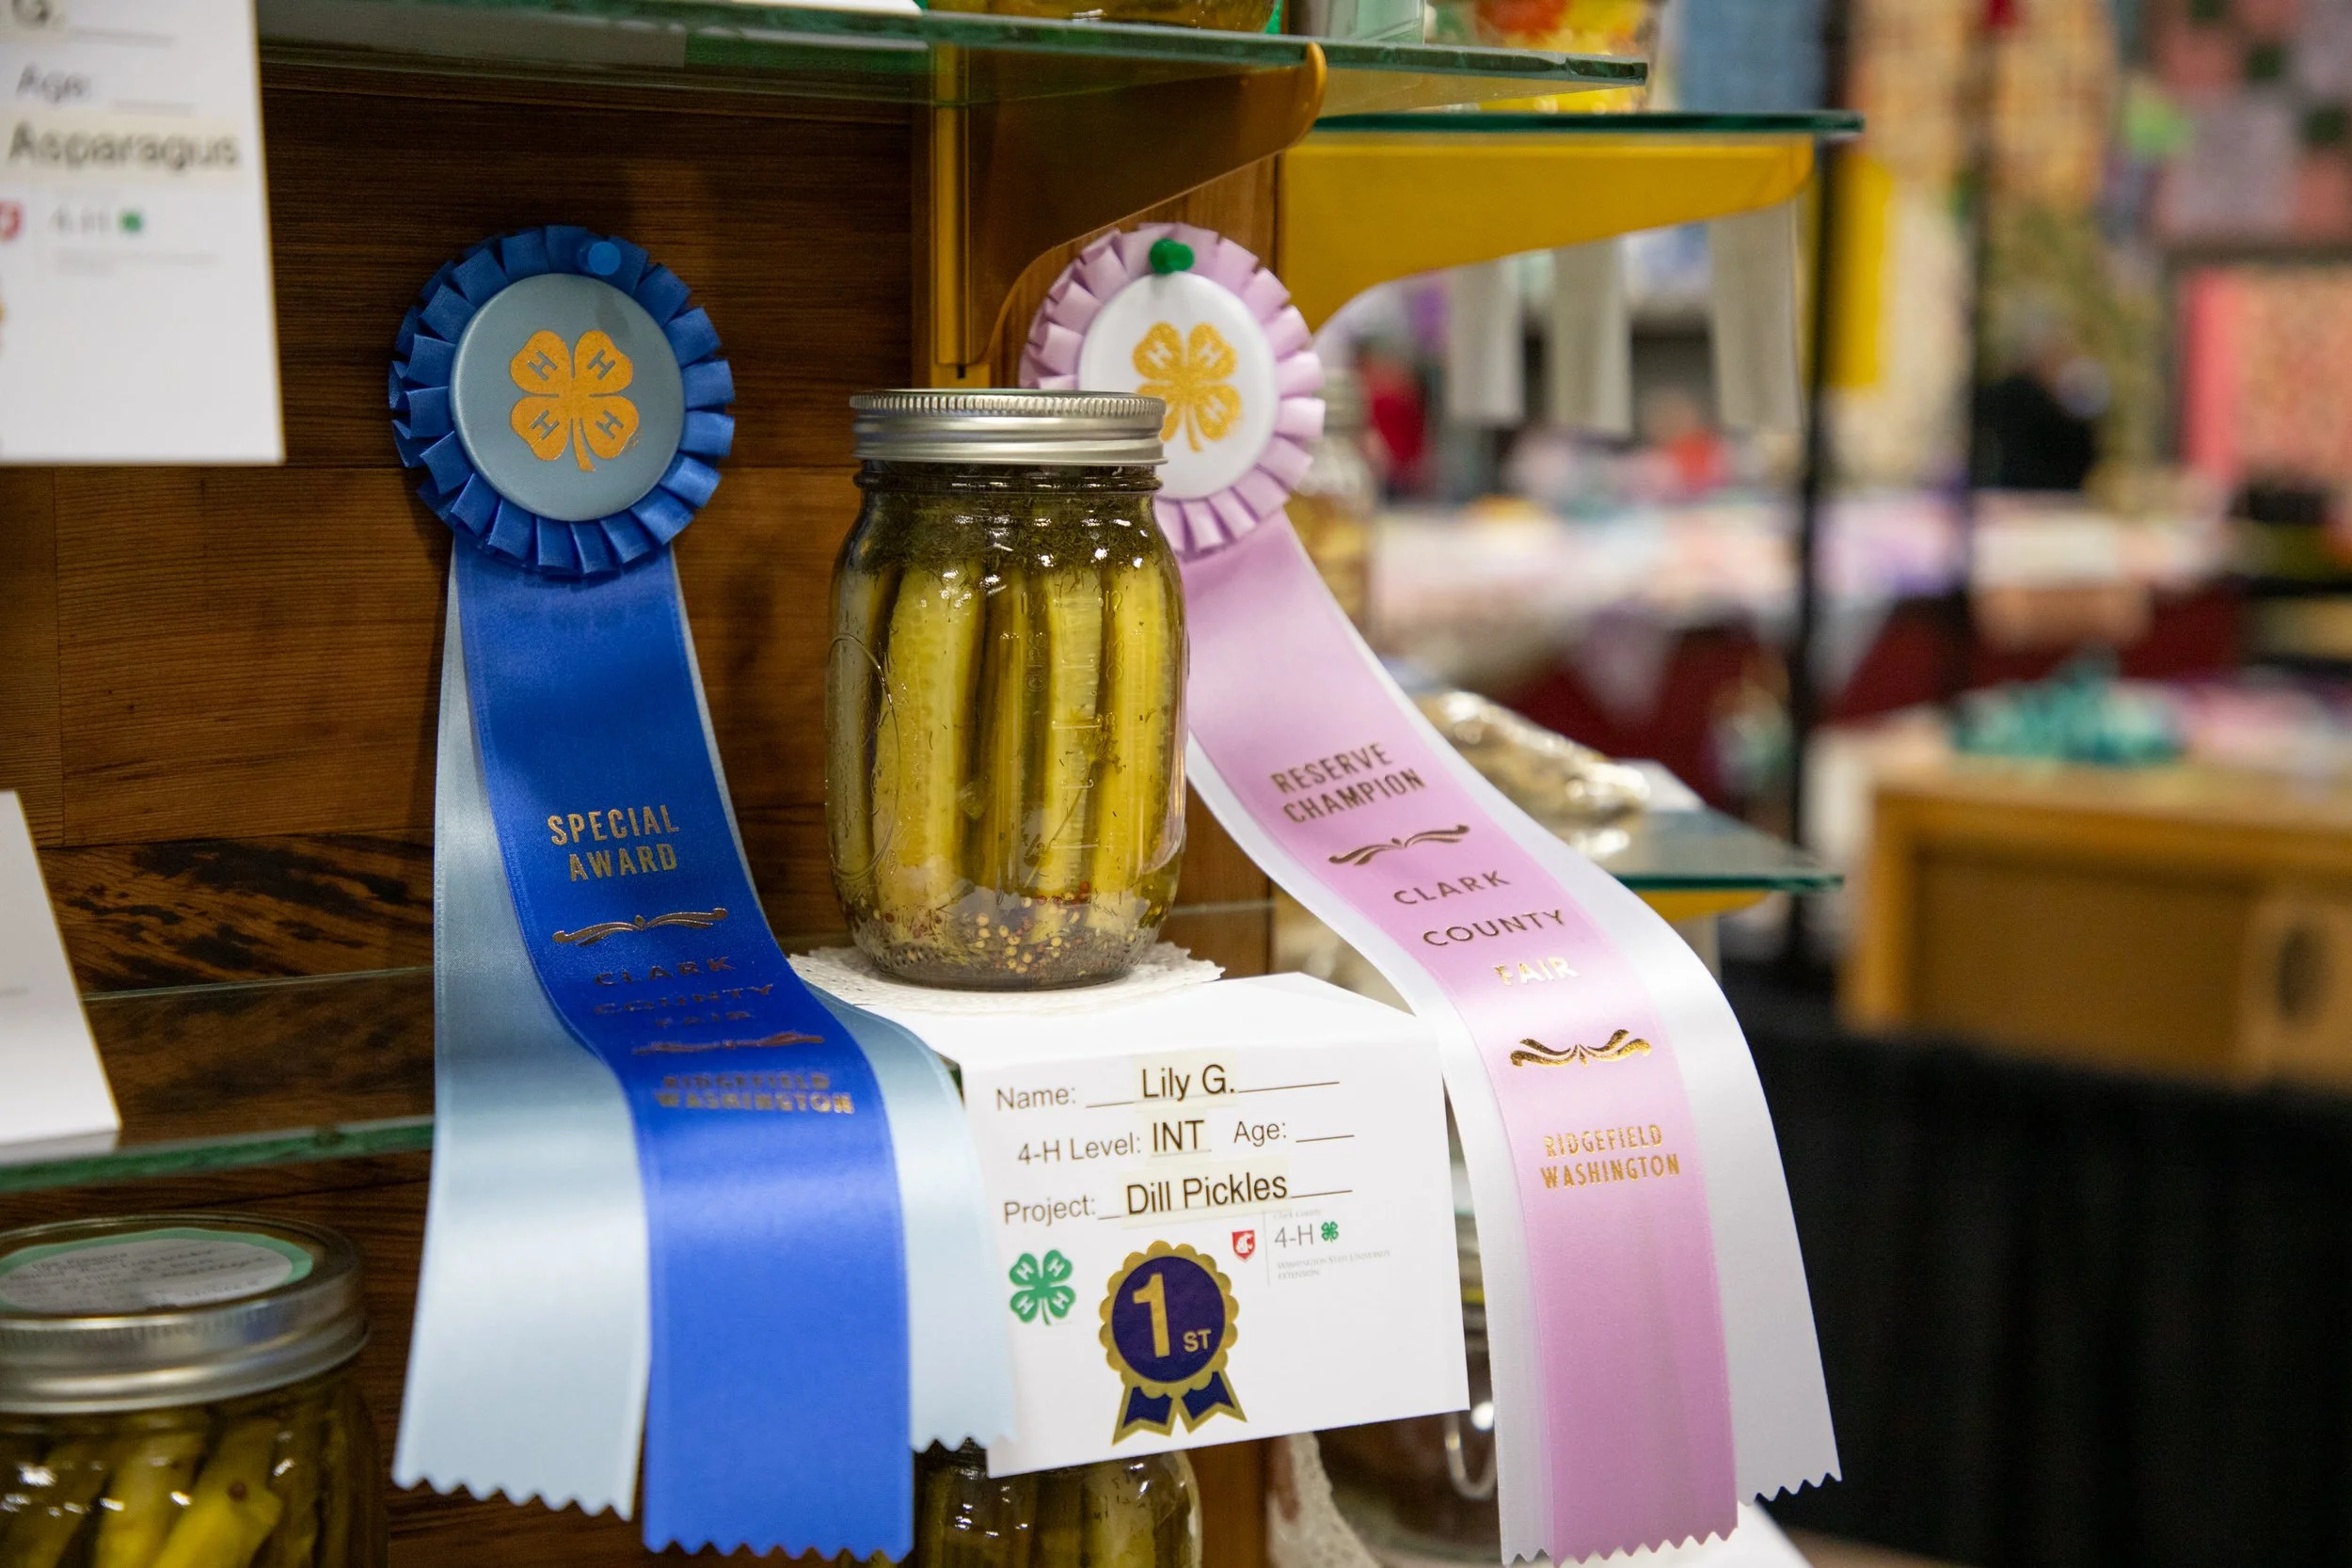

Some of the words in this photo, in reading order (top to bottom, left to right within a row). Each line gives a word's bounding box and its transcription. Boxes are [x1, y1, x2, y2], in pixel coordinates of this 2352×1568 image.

[1270, 742, 1392, 795] RESERVE
[1282, 768, 1425, 825] CHAMPION
[548, 804, 679, 846] SPECIAL
[568, 843, 678, 882] AWARD
[1393, 870, 1512, 906] CLARK
[1422, 909, 1565, 946] COUNTY
[595, 957, 735, 986] CLARK
[1494, 957, 1580, 987] FAIR
[996, 1085, 1076, 1112] Name:
[1142, 1067, 1191, 1101] Lily
[1202, 1064, 1235, 1096] G.
[1018, 1139, 1060, 1165] 4-H
[1070, 1132, 1141, 1161] Level:
[1152, 1119, 1204, 1153] INT
[1234, 1119, 1286, 1148] Age:
[1543, 1124, 1662, 1159] RIDGEFIELD
[1540, 1153, 1679, 1190] WASHINGTON
[1004, 1196, 1096, 1227] Project:
[1126, 1180, 1171, 1216] Dill
[1183, 1171, 1288, 1210] Pickles
[1274, 1223, 1314, 1248] 4-H
[1133, 1273, 1171, 1358] 1
[1183, 1328, 1212, 1354] ST
